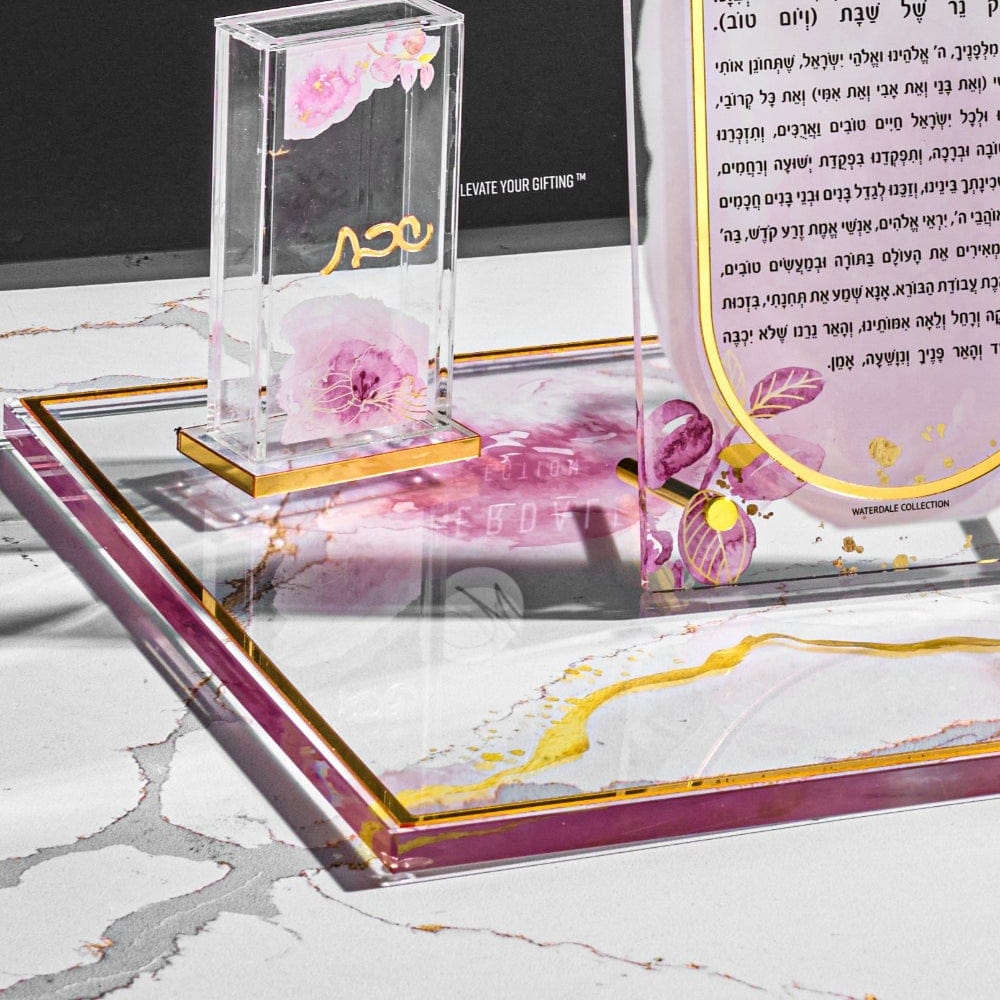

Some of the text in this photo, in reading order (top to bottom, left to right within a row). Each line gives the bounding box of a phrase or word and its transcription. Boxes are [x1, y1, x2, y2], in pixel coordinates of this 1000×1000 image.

[459, 180, 498, 198] LEVATE
[499, 177, 530, 194] YOUR
[851, 499, 951, 517] WATERDALE COLLECTION
